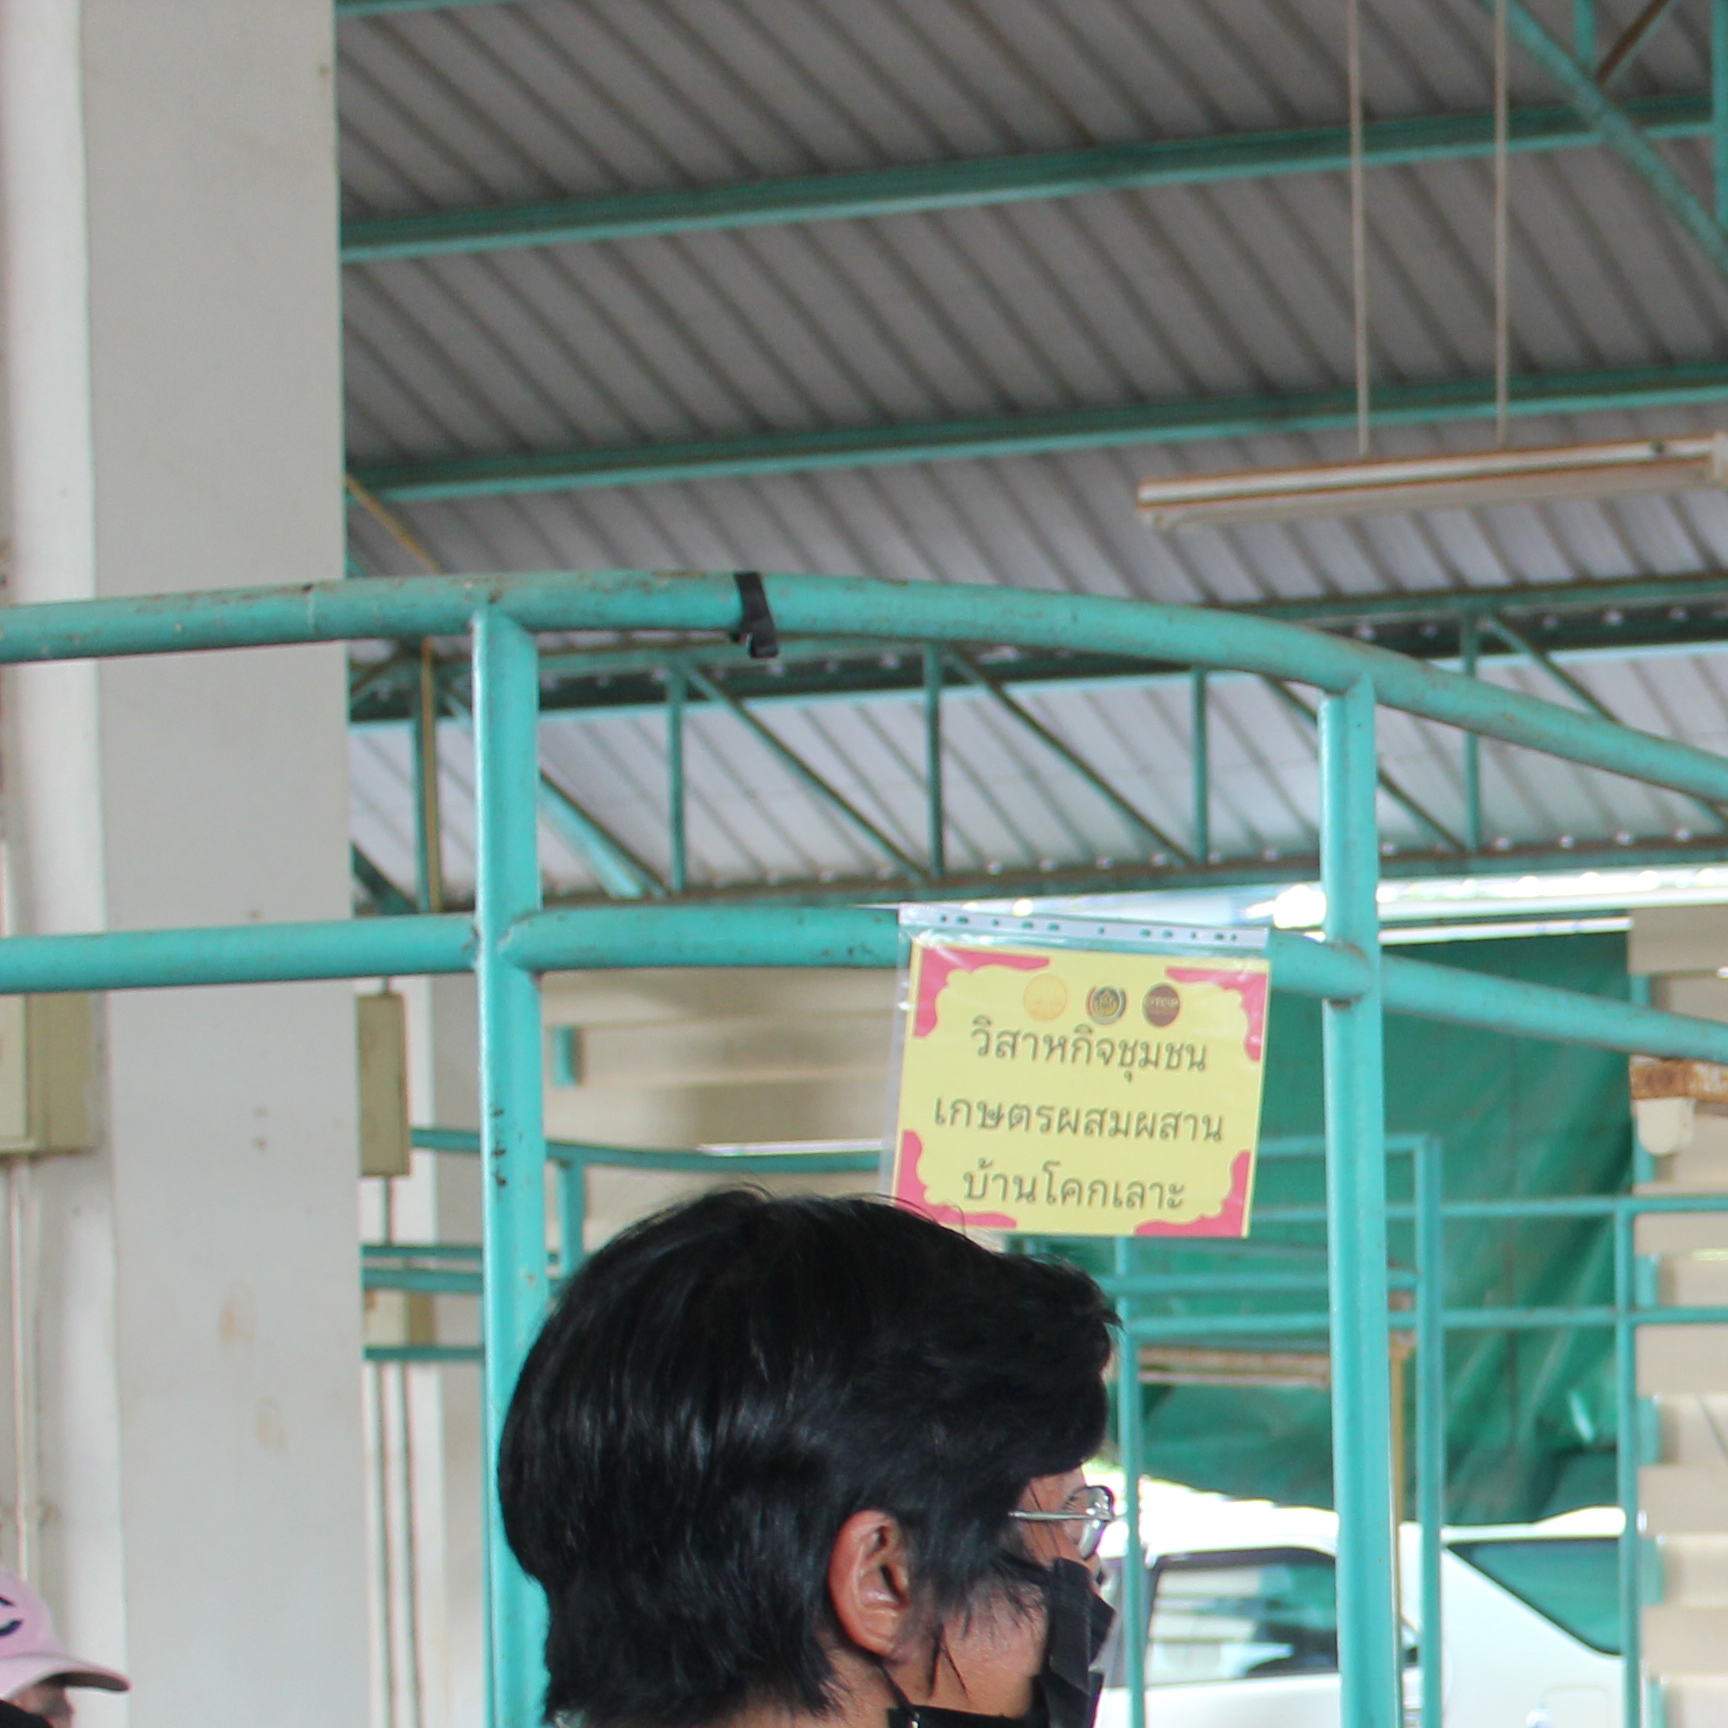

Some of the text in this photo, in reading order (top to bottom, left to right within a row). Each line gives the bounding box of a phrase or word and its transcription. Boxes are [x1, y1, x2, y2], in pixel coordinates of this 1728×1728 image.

[970, 1015, 1207, 1082] วิสาหกิจชุมชน
[932, 1097, 1223, 1142] เกษตรผสมผสาน
[963, 1156, 1185, 1210] บ้านโคกเลาะ
